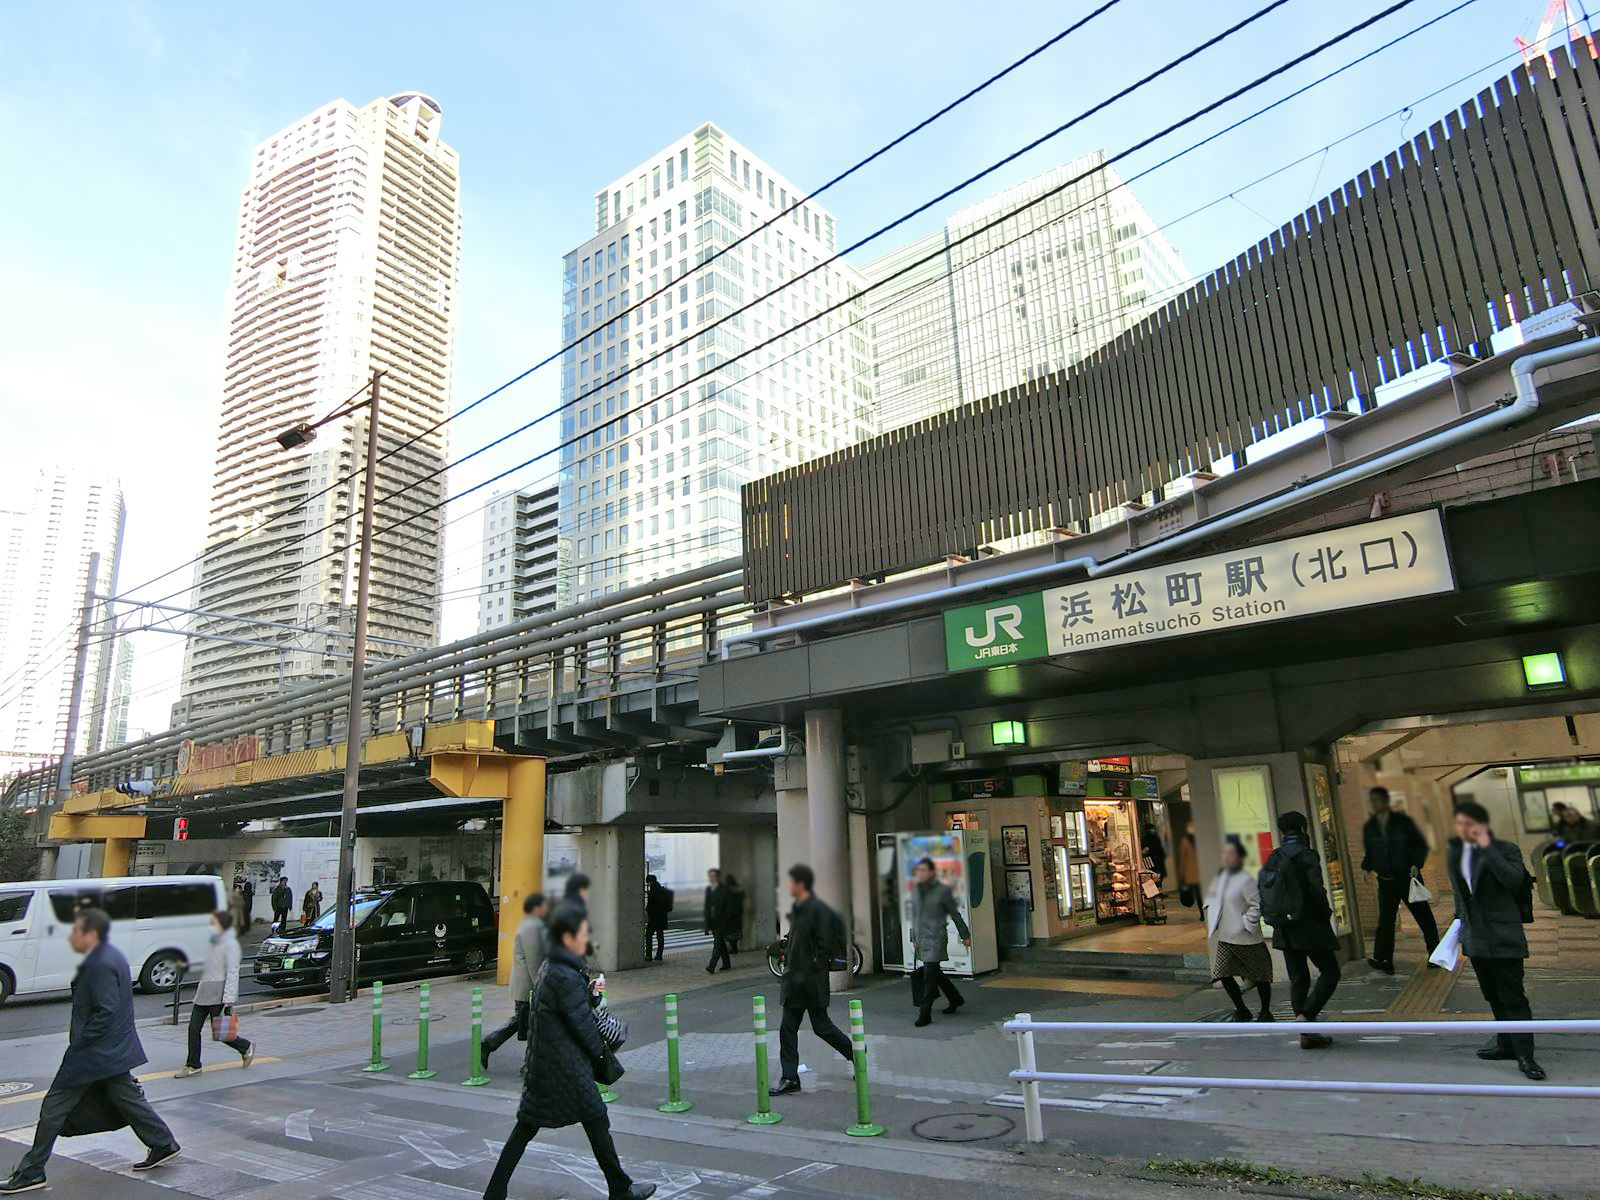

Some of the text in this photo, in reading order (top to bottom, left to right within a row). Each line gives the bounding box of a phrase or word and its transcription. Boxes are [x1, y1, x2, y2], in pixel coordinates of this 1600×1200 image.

[965, 604, 1024, 647] JR
[1062, 599, 1286, 647] Hamamatsuchō Station
[974, 642, 1019, 660] JR東日本
